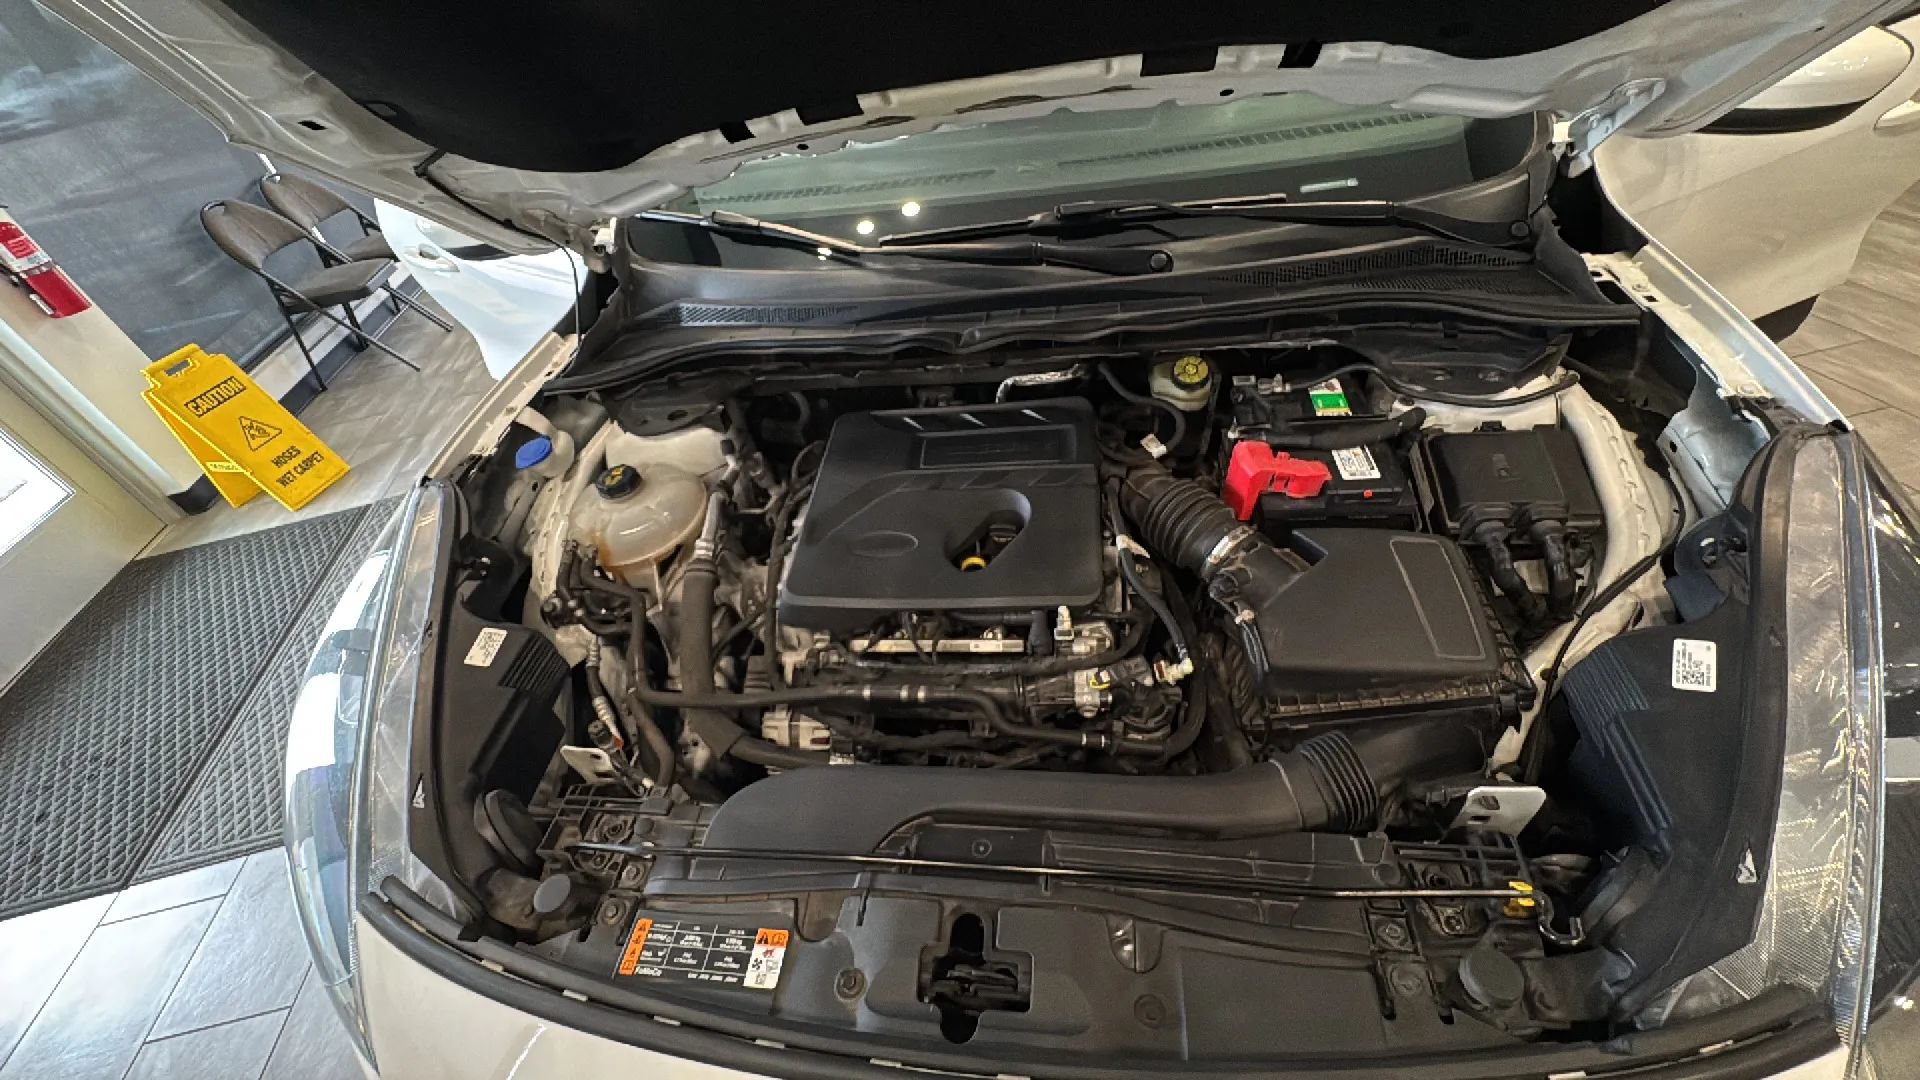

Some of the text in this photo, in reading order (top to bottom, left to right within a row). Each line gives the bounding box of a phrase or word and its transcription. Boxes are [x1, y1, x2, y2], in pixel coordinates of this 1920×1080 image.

[186, 377, 245, 416] CAUTION
[271, 445, 301, 468] HOSES
[275, 451, 325, 488] WET CARPET
